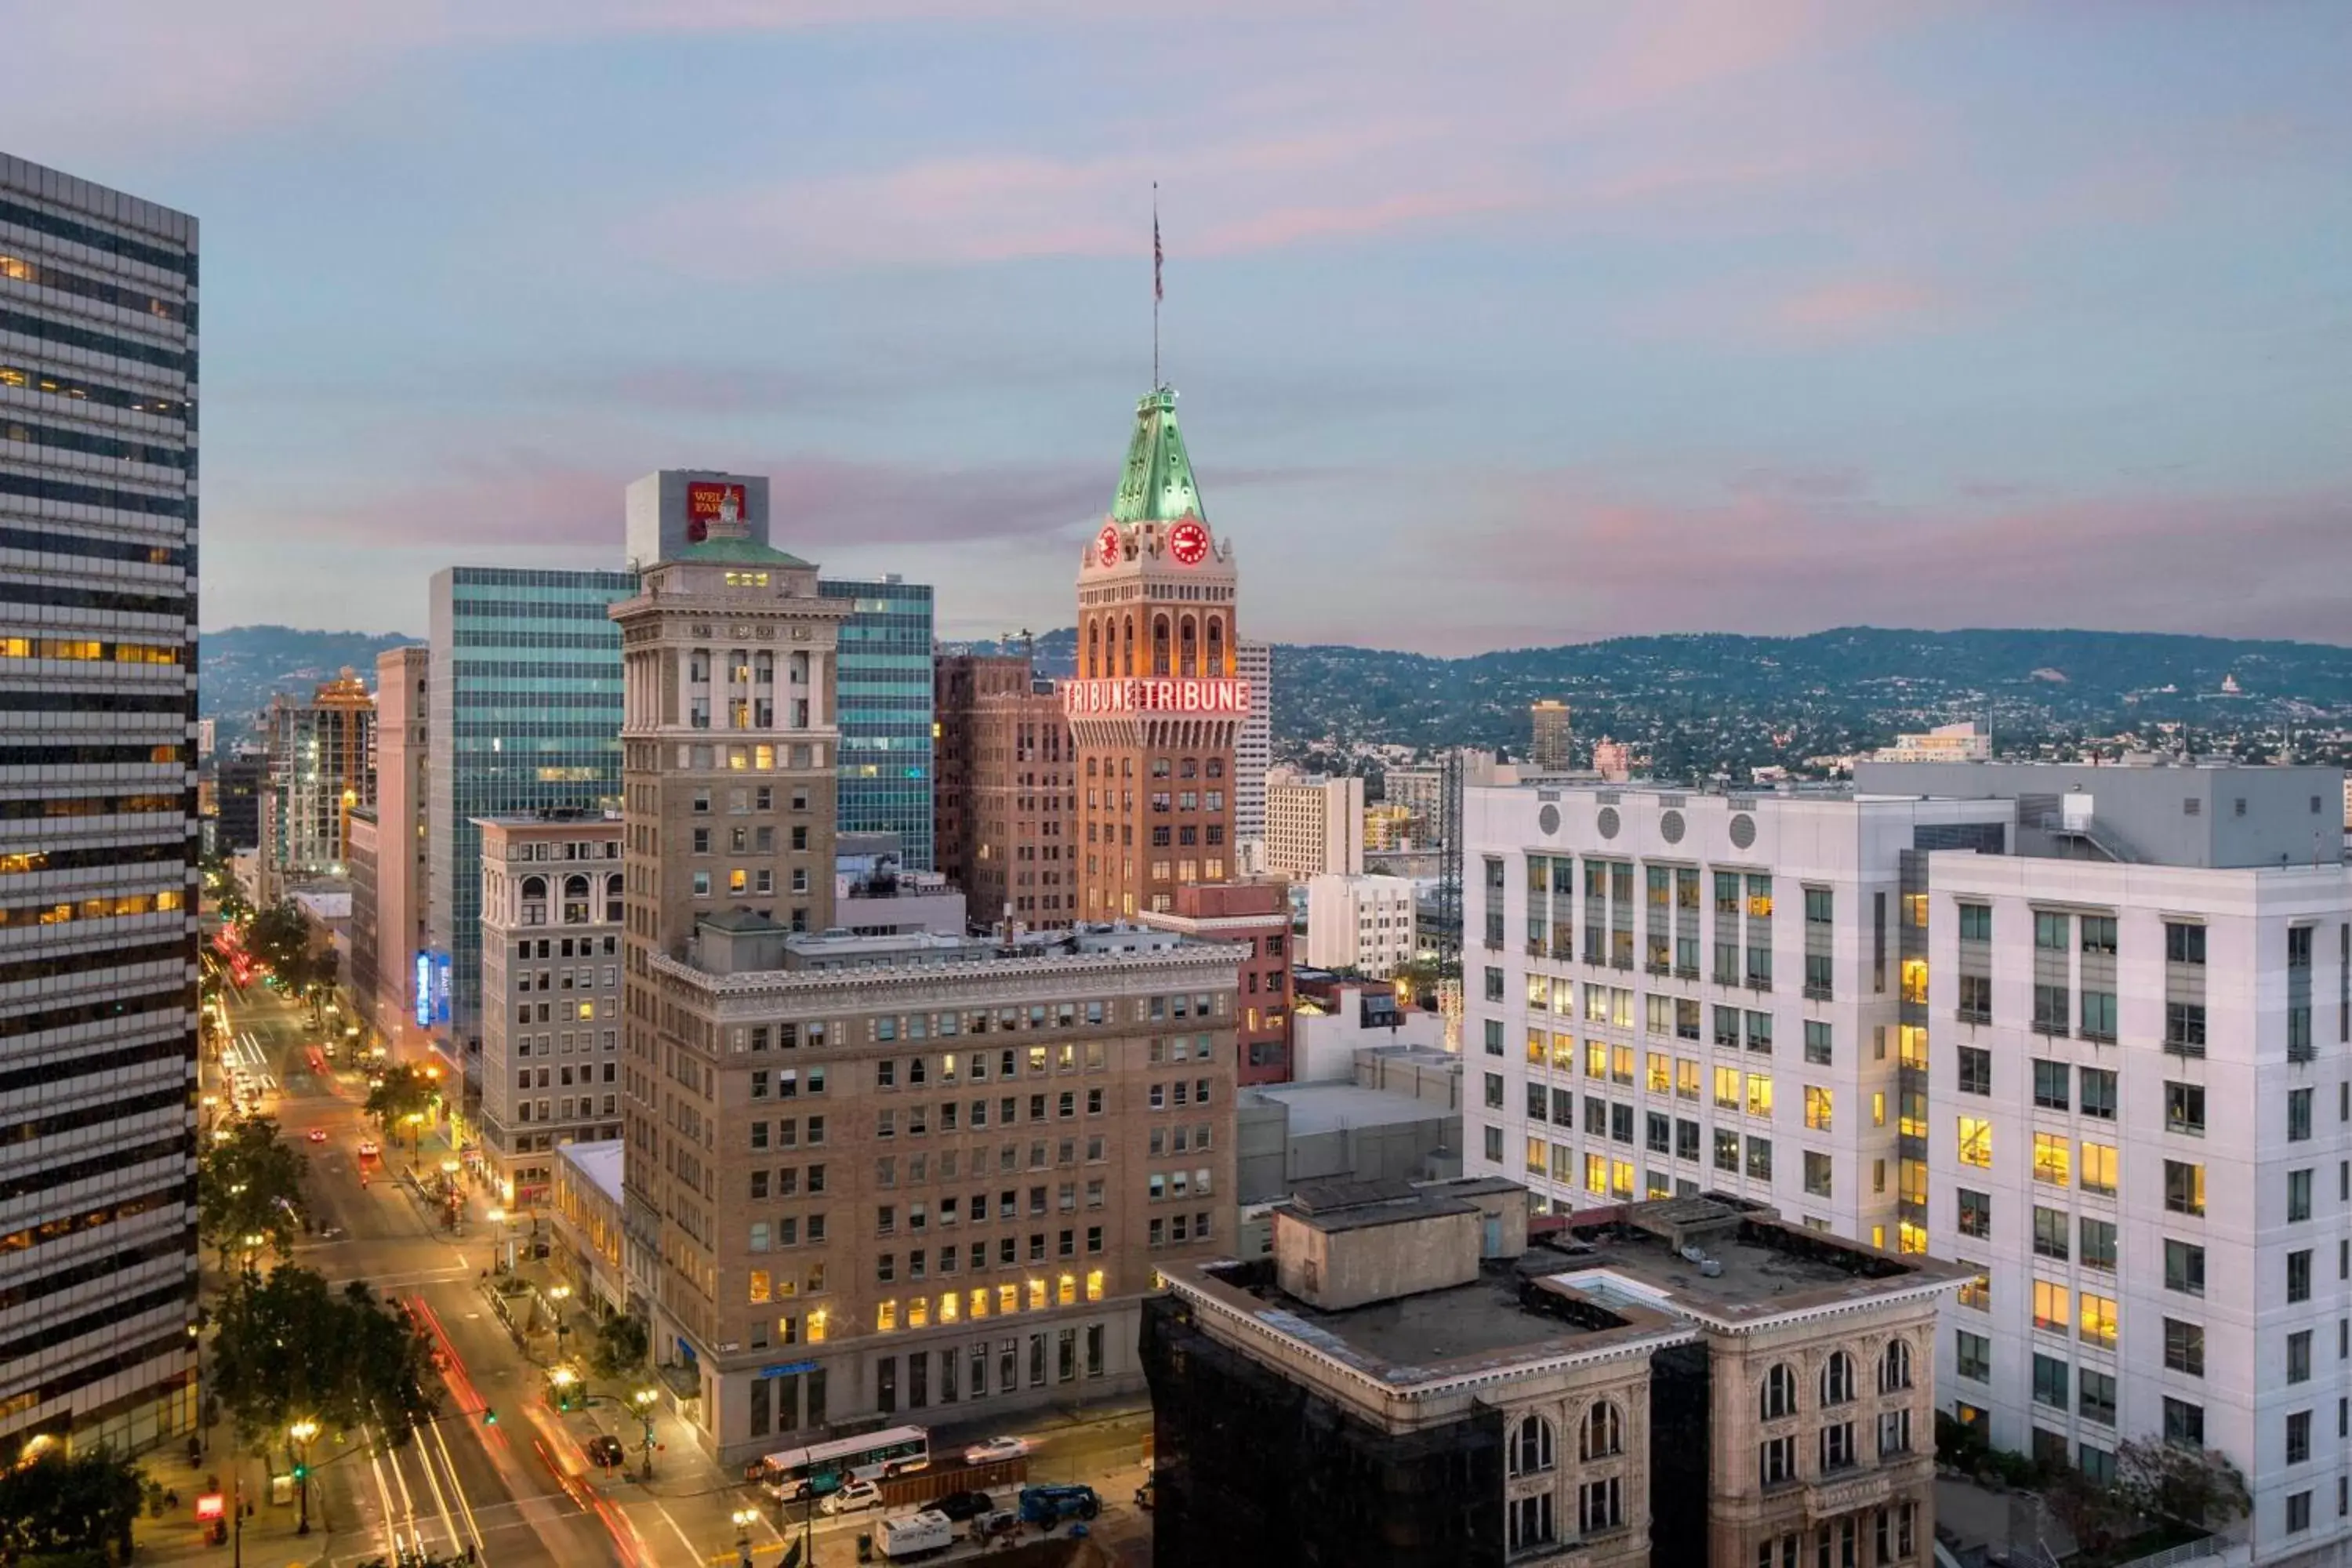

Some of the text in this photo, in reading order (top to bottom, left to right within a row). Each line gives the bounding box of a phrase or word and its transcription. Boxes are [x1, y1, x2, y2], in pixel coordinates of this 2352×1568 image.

[695, 492, 739, 502] WELS
[1065, 681, 1132, 712] TRIBUNE
[1142, 681, 1249, 711] TRIBUNE
